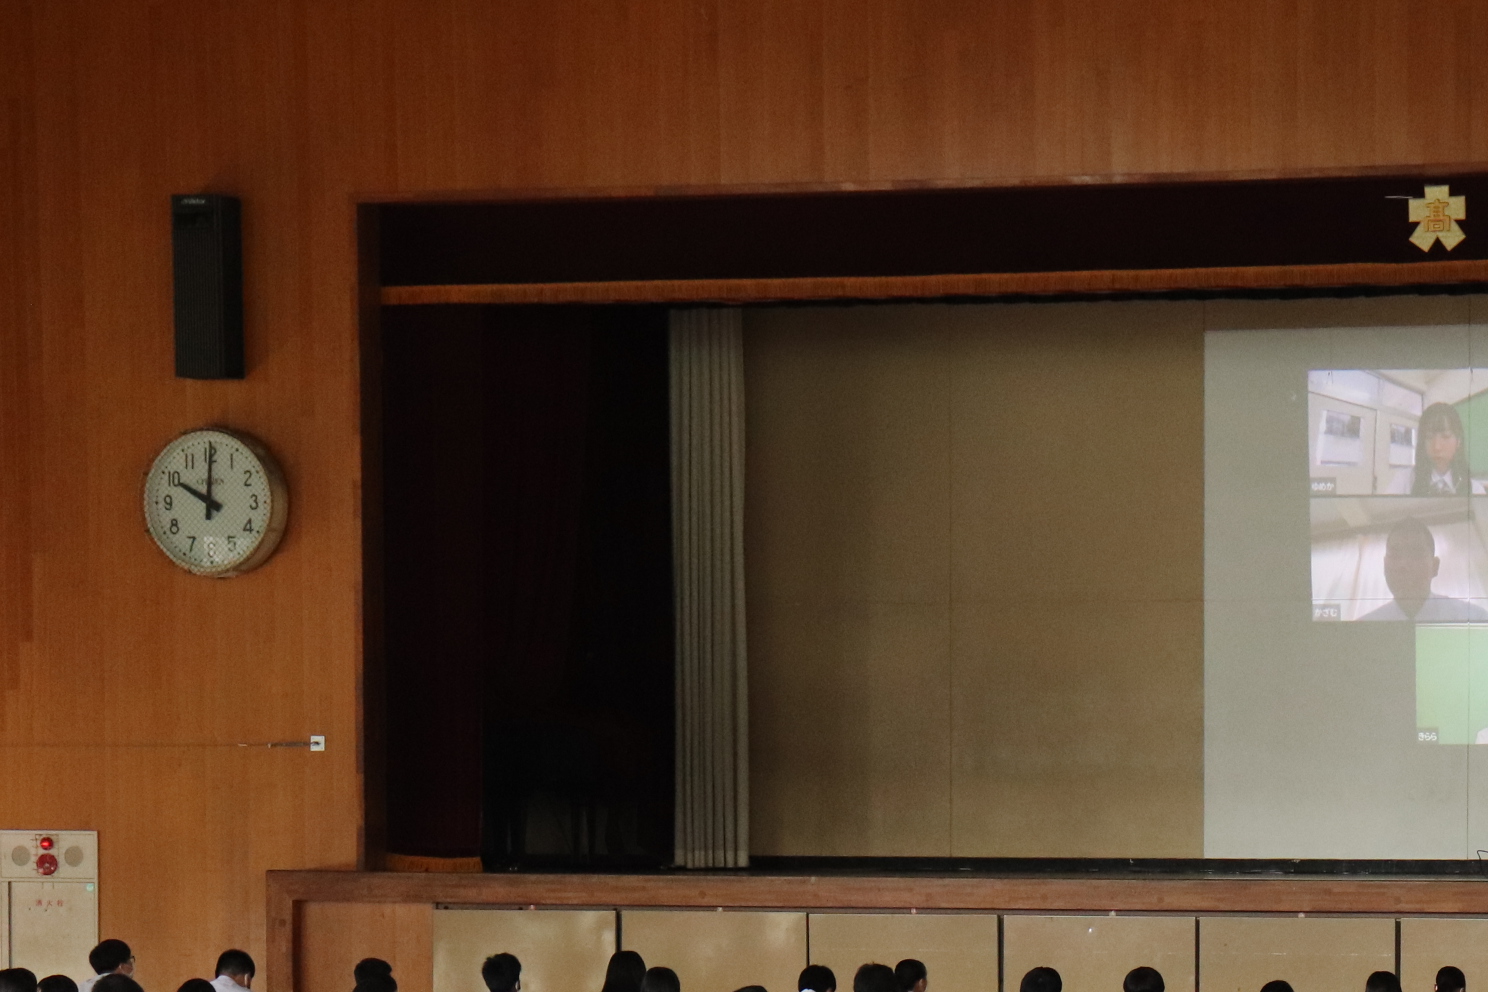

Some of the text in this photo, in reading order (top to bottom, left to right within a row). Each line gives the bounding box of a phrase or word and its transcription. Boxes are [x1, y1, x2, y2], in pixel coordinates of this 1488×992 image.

[185, 453, 195, 470] 11
[167, 471, 181, 487] 10
[243, 470, 253, 487] 2
[163, 494, 173, 511] 9
[249, 494, 259, 510] 3
[169, 518, 180, 535] 8
[242, 518, 254, 534] 4
[187, 536, 197, 552] 7
[227, 536, 237, 552] 5
